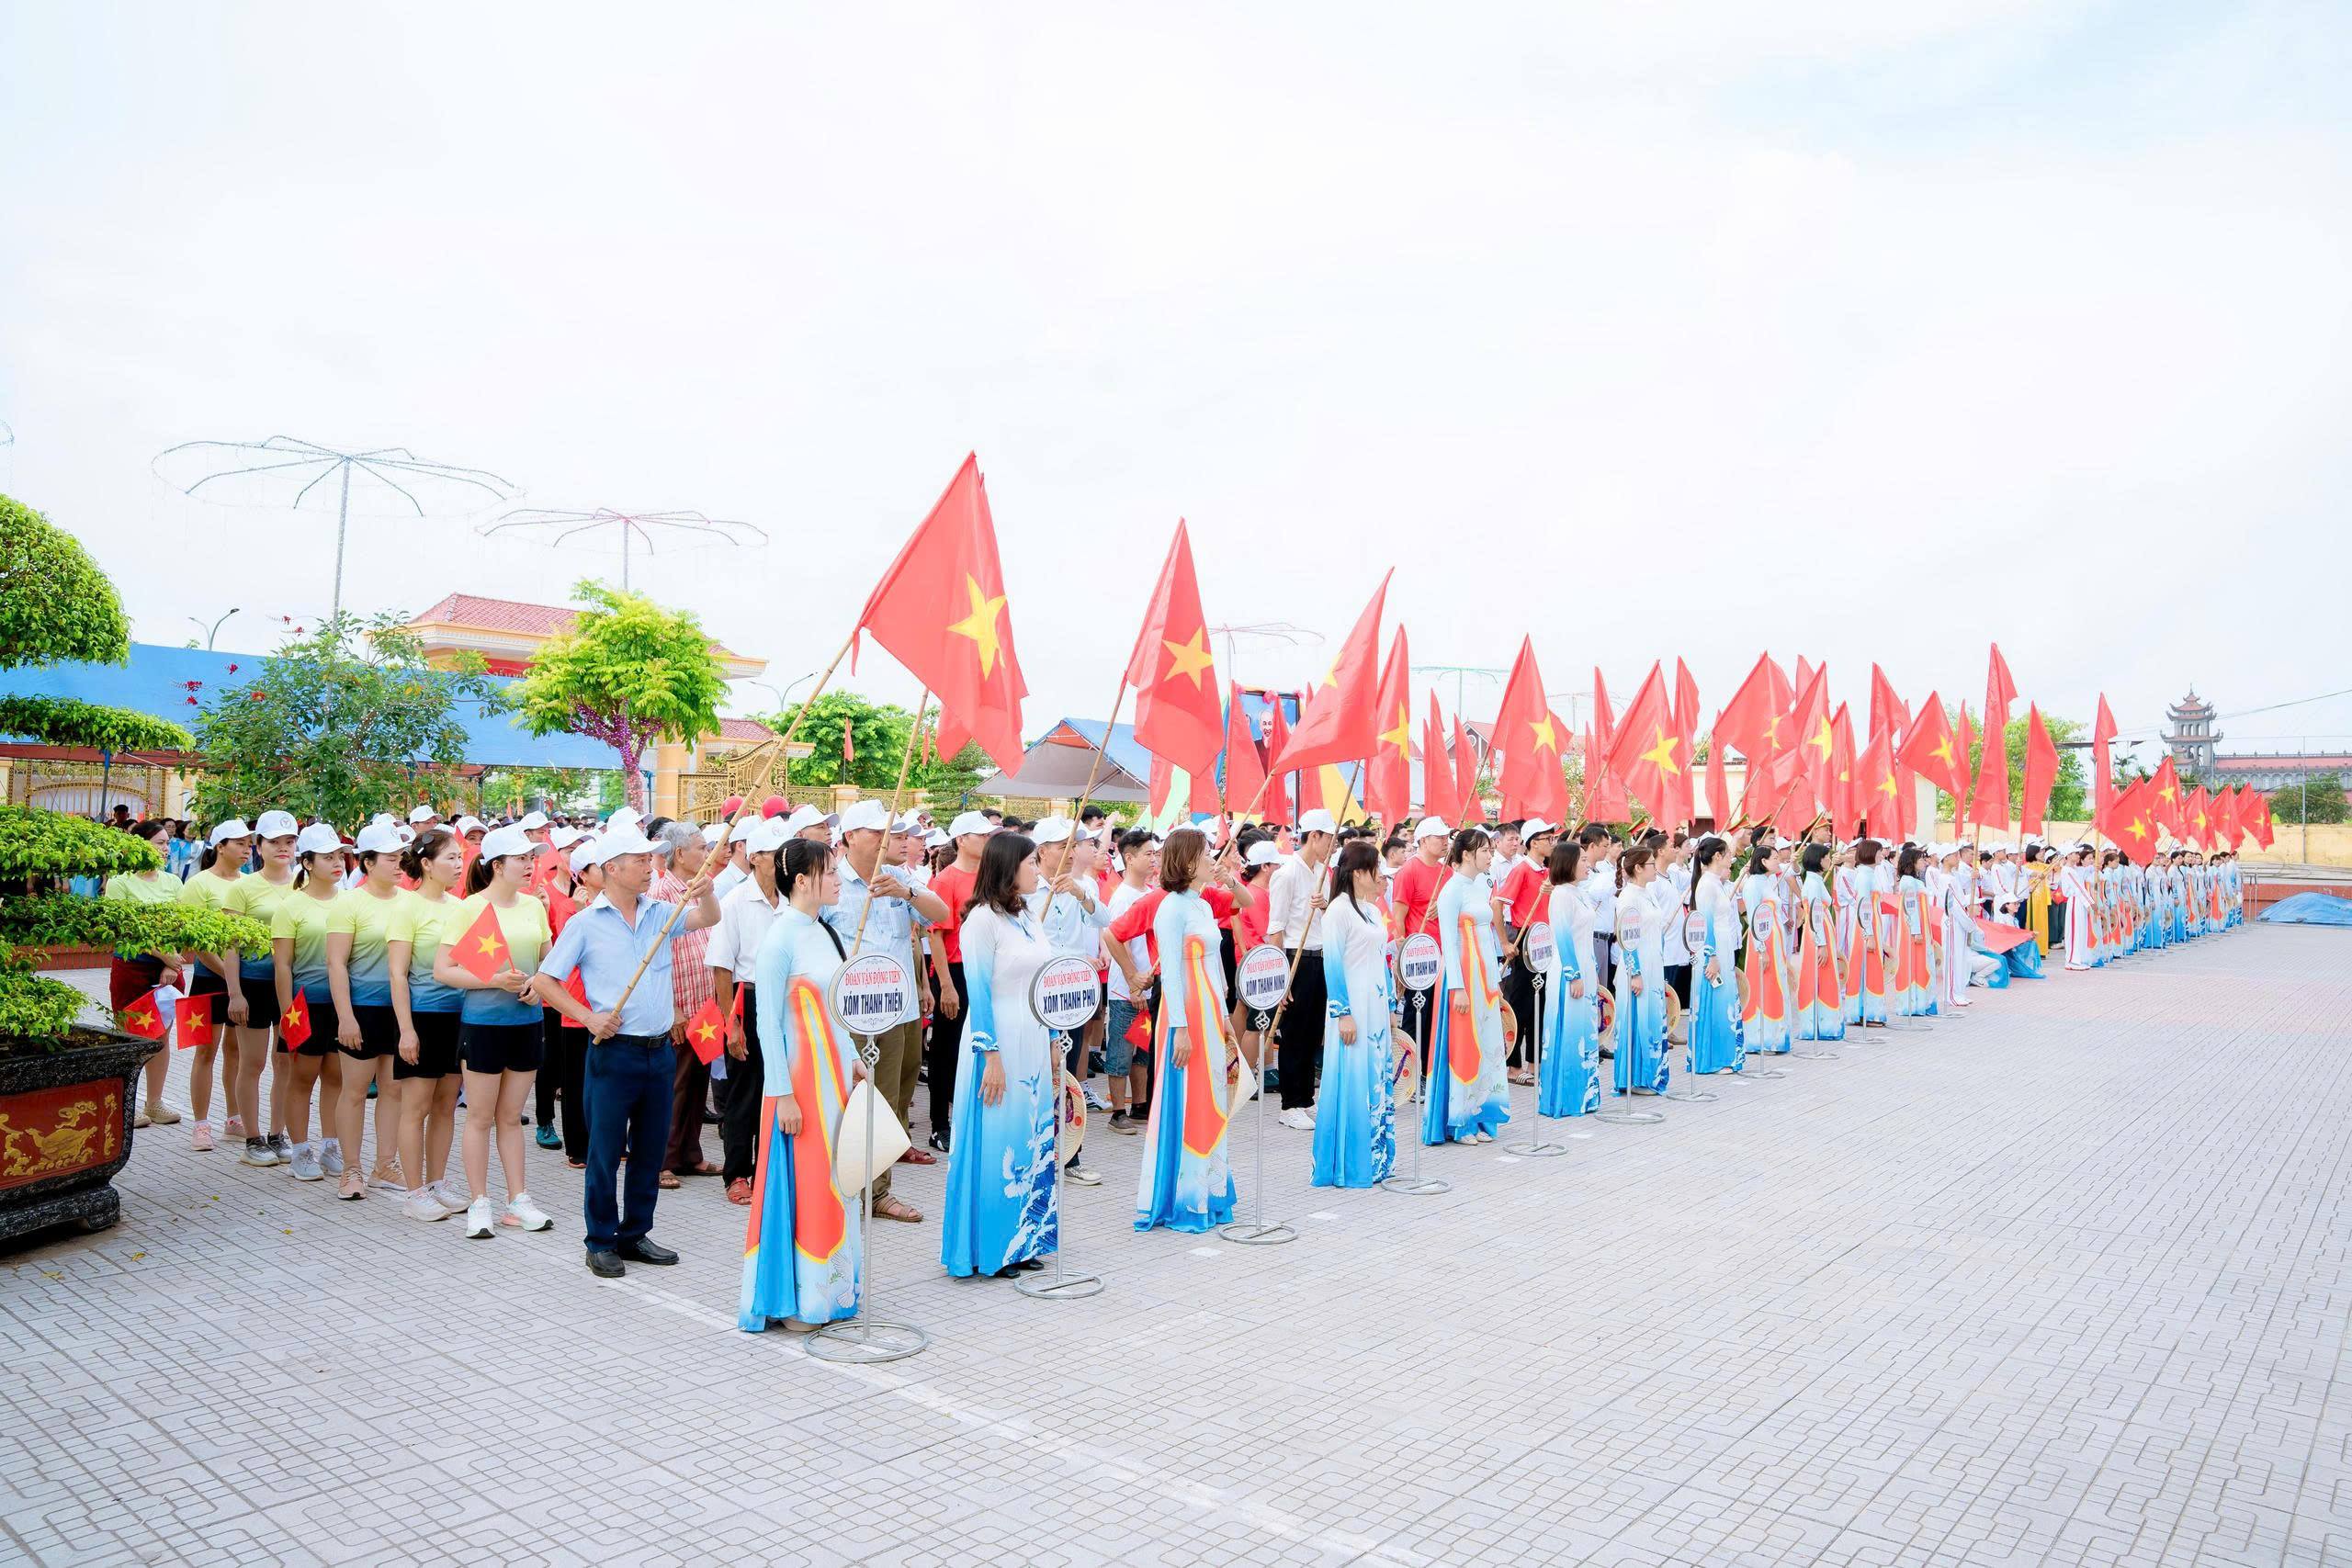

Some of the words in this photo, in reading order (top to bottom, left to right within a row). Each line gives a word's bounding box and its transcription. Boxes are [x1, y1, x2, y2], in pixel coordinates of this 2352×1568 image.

[1043, 991, 1058, 1014] XÓM
[1059, 991, 1080, 1011] THANH
[1082, 985, 1095, 1008] PHÚ
[1246, 977, 1257, 997] XÓM
[1258, 977, 1272, 994] THANH
[842, 991, 859, 1016] XÓM
[861, 994, 882, 1014] THANH
[885, 987, 903, 1017] THIỆN
